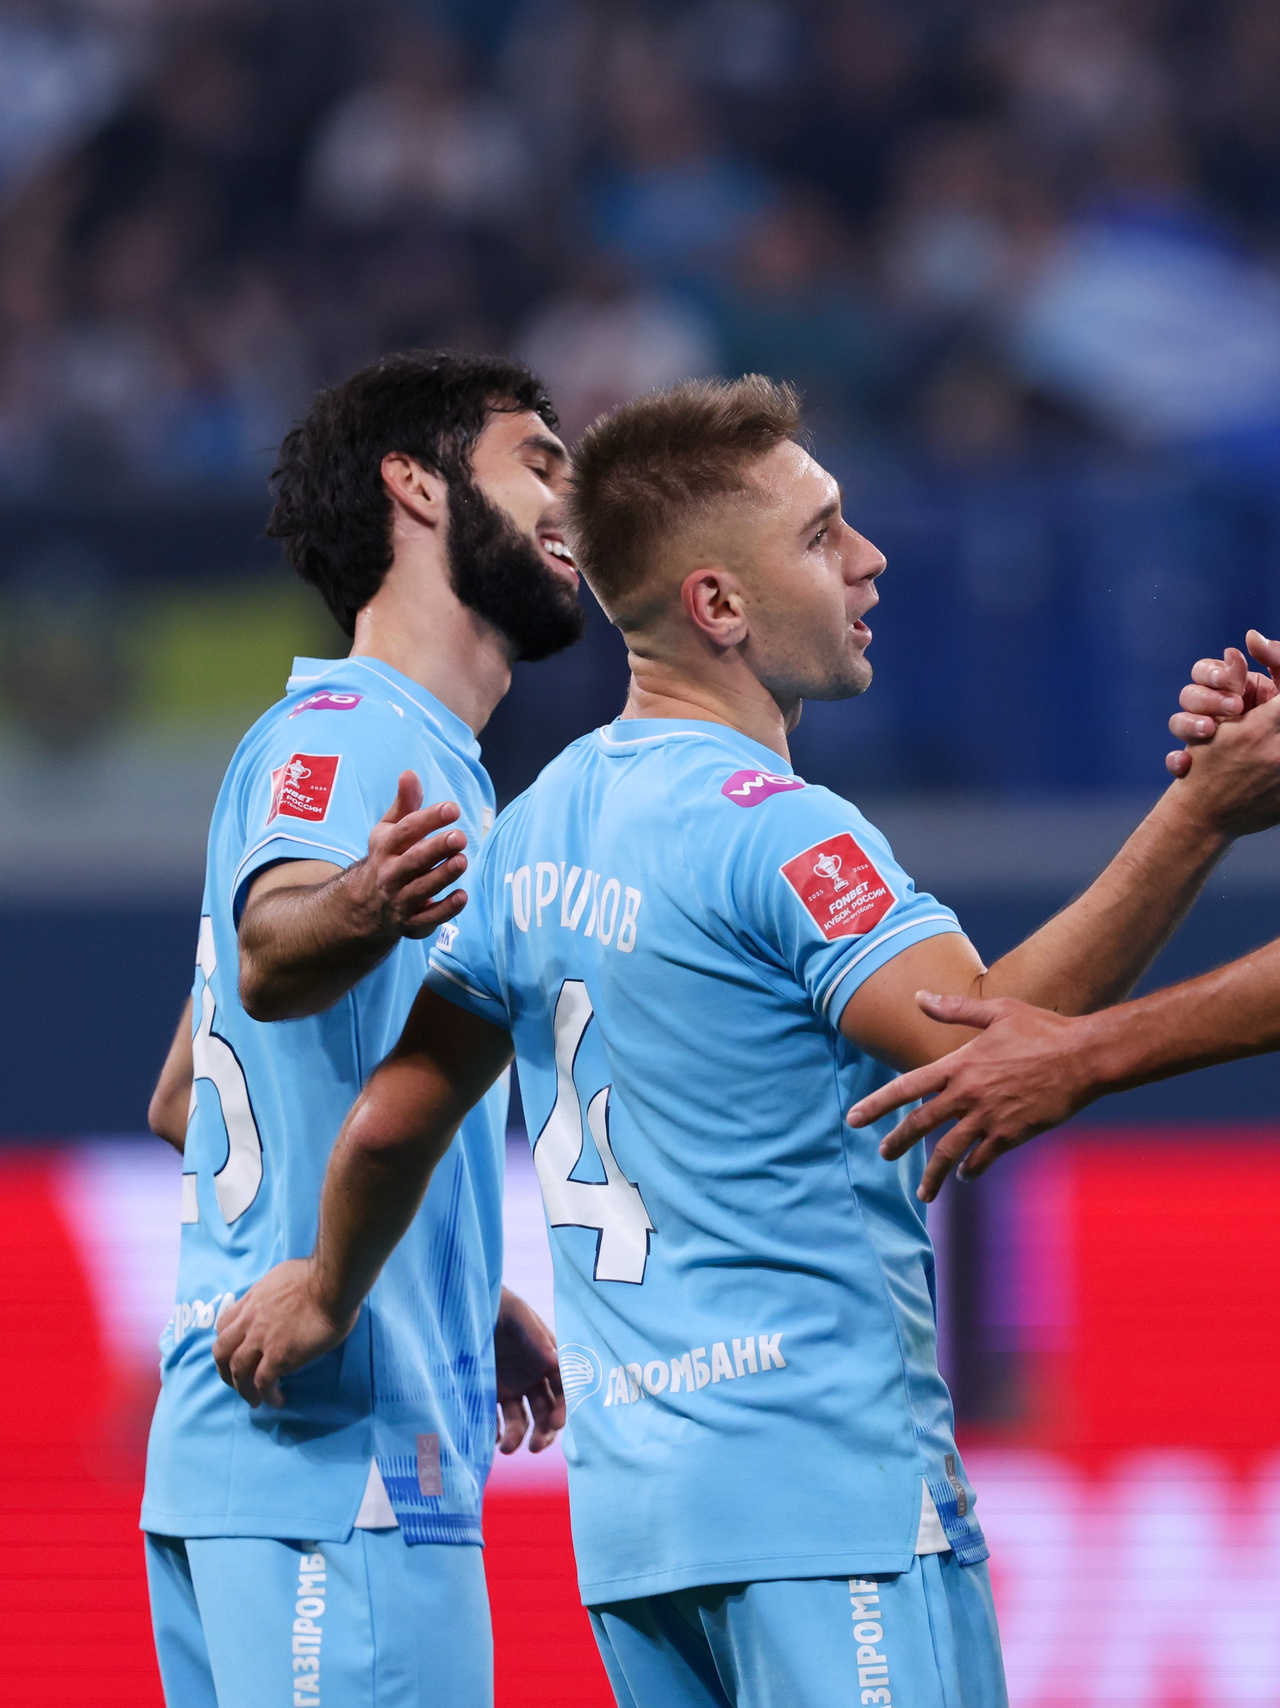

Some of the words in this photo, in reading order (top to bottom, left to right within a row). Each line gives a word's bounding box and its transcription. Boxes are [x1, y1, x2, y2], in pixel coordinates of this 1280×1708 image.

[286, 794, 323, 813] РОССИИ
[728, 772, 795, 797] wb
[823, 907, 852, 931] КУБОК
[851, 887, 887, 910] РОССИИ
[828, 881, 869, 915] FONBET
[533, 978, 658, 1285] 4
[292, 1545, 327, 1708] ГАЗПРОМБ
